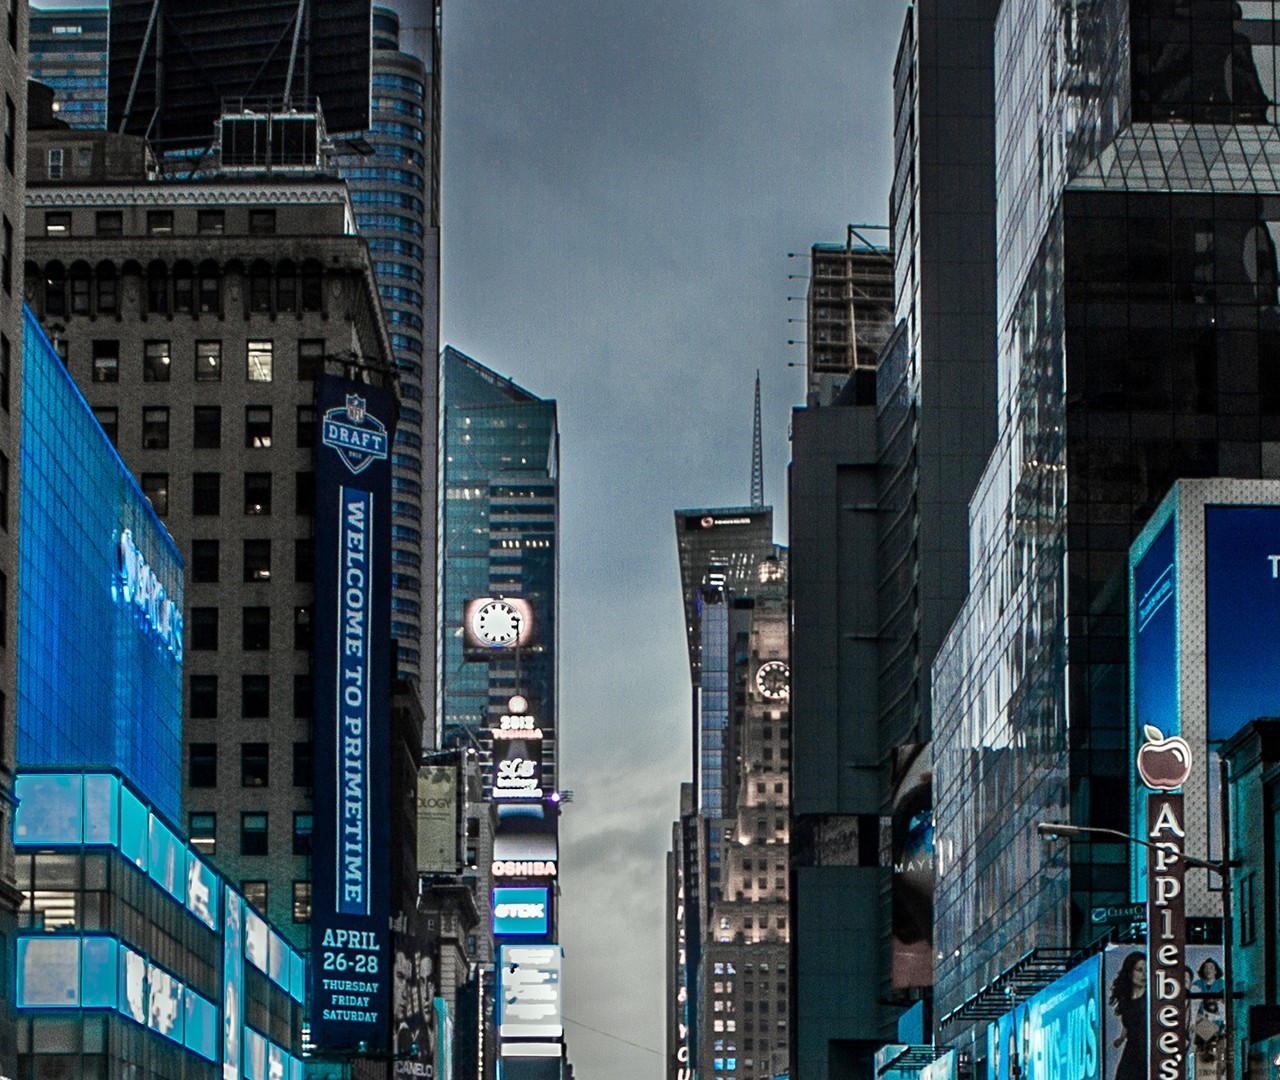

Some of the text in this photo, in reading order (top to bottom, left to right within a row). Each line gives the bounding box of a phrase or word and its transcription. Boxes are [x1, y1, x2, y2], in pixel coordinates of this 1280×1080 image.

[328, 425, 382, 450] DRAFT
[344, 500, 365, 904] WELCOME TO PRIMETIME
[491, 861, 556, 876] OSHIBA
[322, 928, 380, 951] APRIL
[323, 952, 378, 974] 26-28
[322, 979, 379, 994] THURSDAY
[331, 995, 371, 1008] FRIDAY
[322, 1009, 379, 1023] SATURDAY
